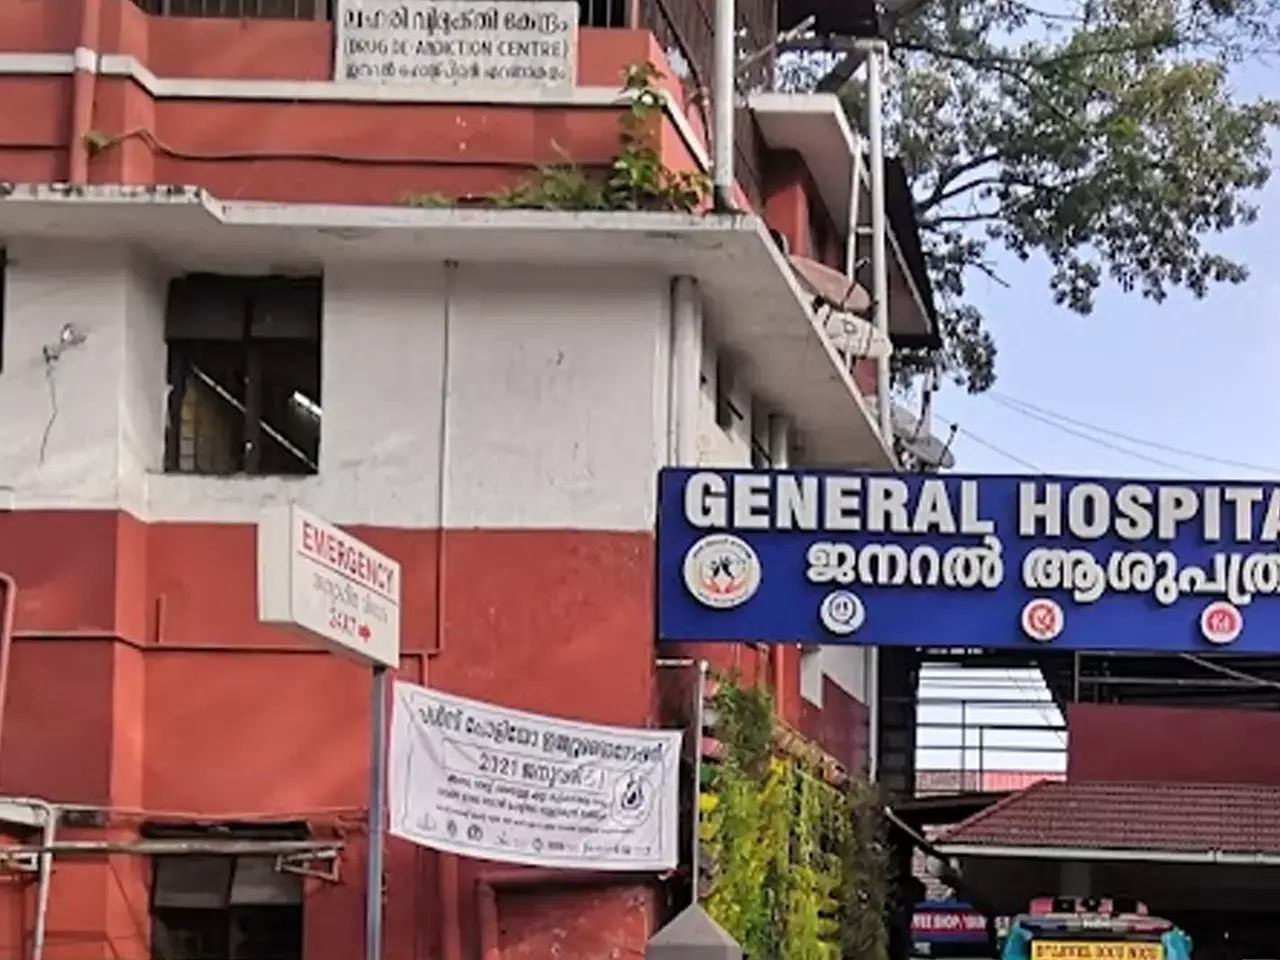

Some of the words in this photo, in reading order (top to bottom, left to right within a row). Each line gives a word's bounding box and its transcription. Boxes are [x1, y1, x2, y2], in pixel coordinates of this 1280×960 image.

[684, 471, 996, 536] GENERAL
[303, 519, 394, 593] EMERGENCY
[806, 534, 1004, 588] ജനറൽ
